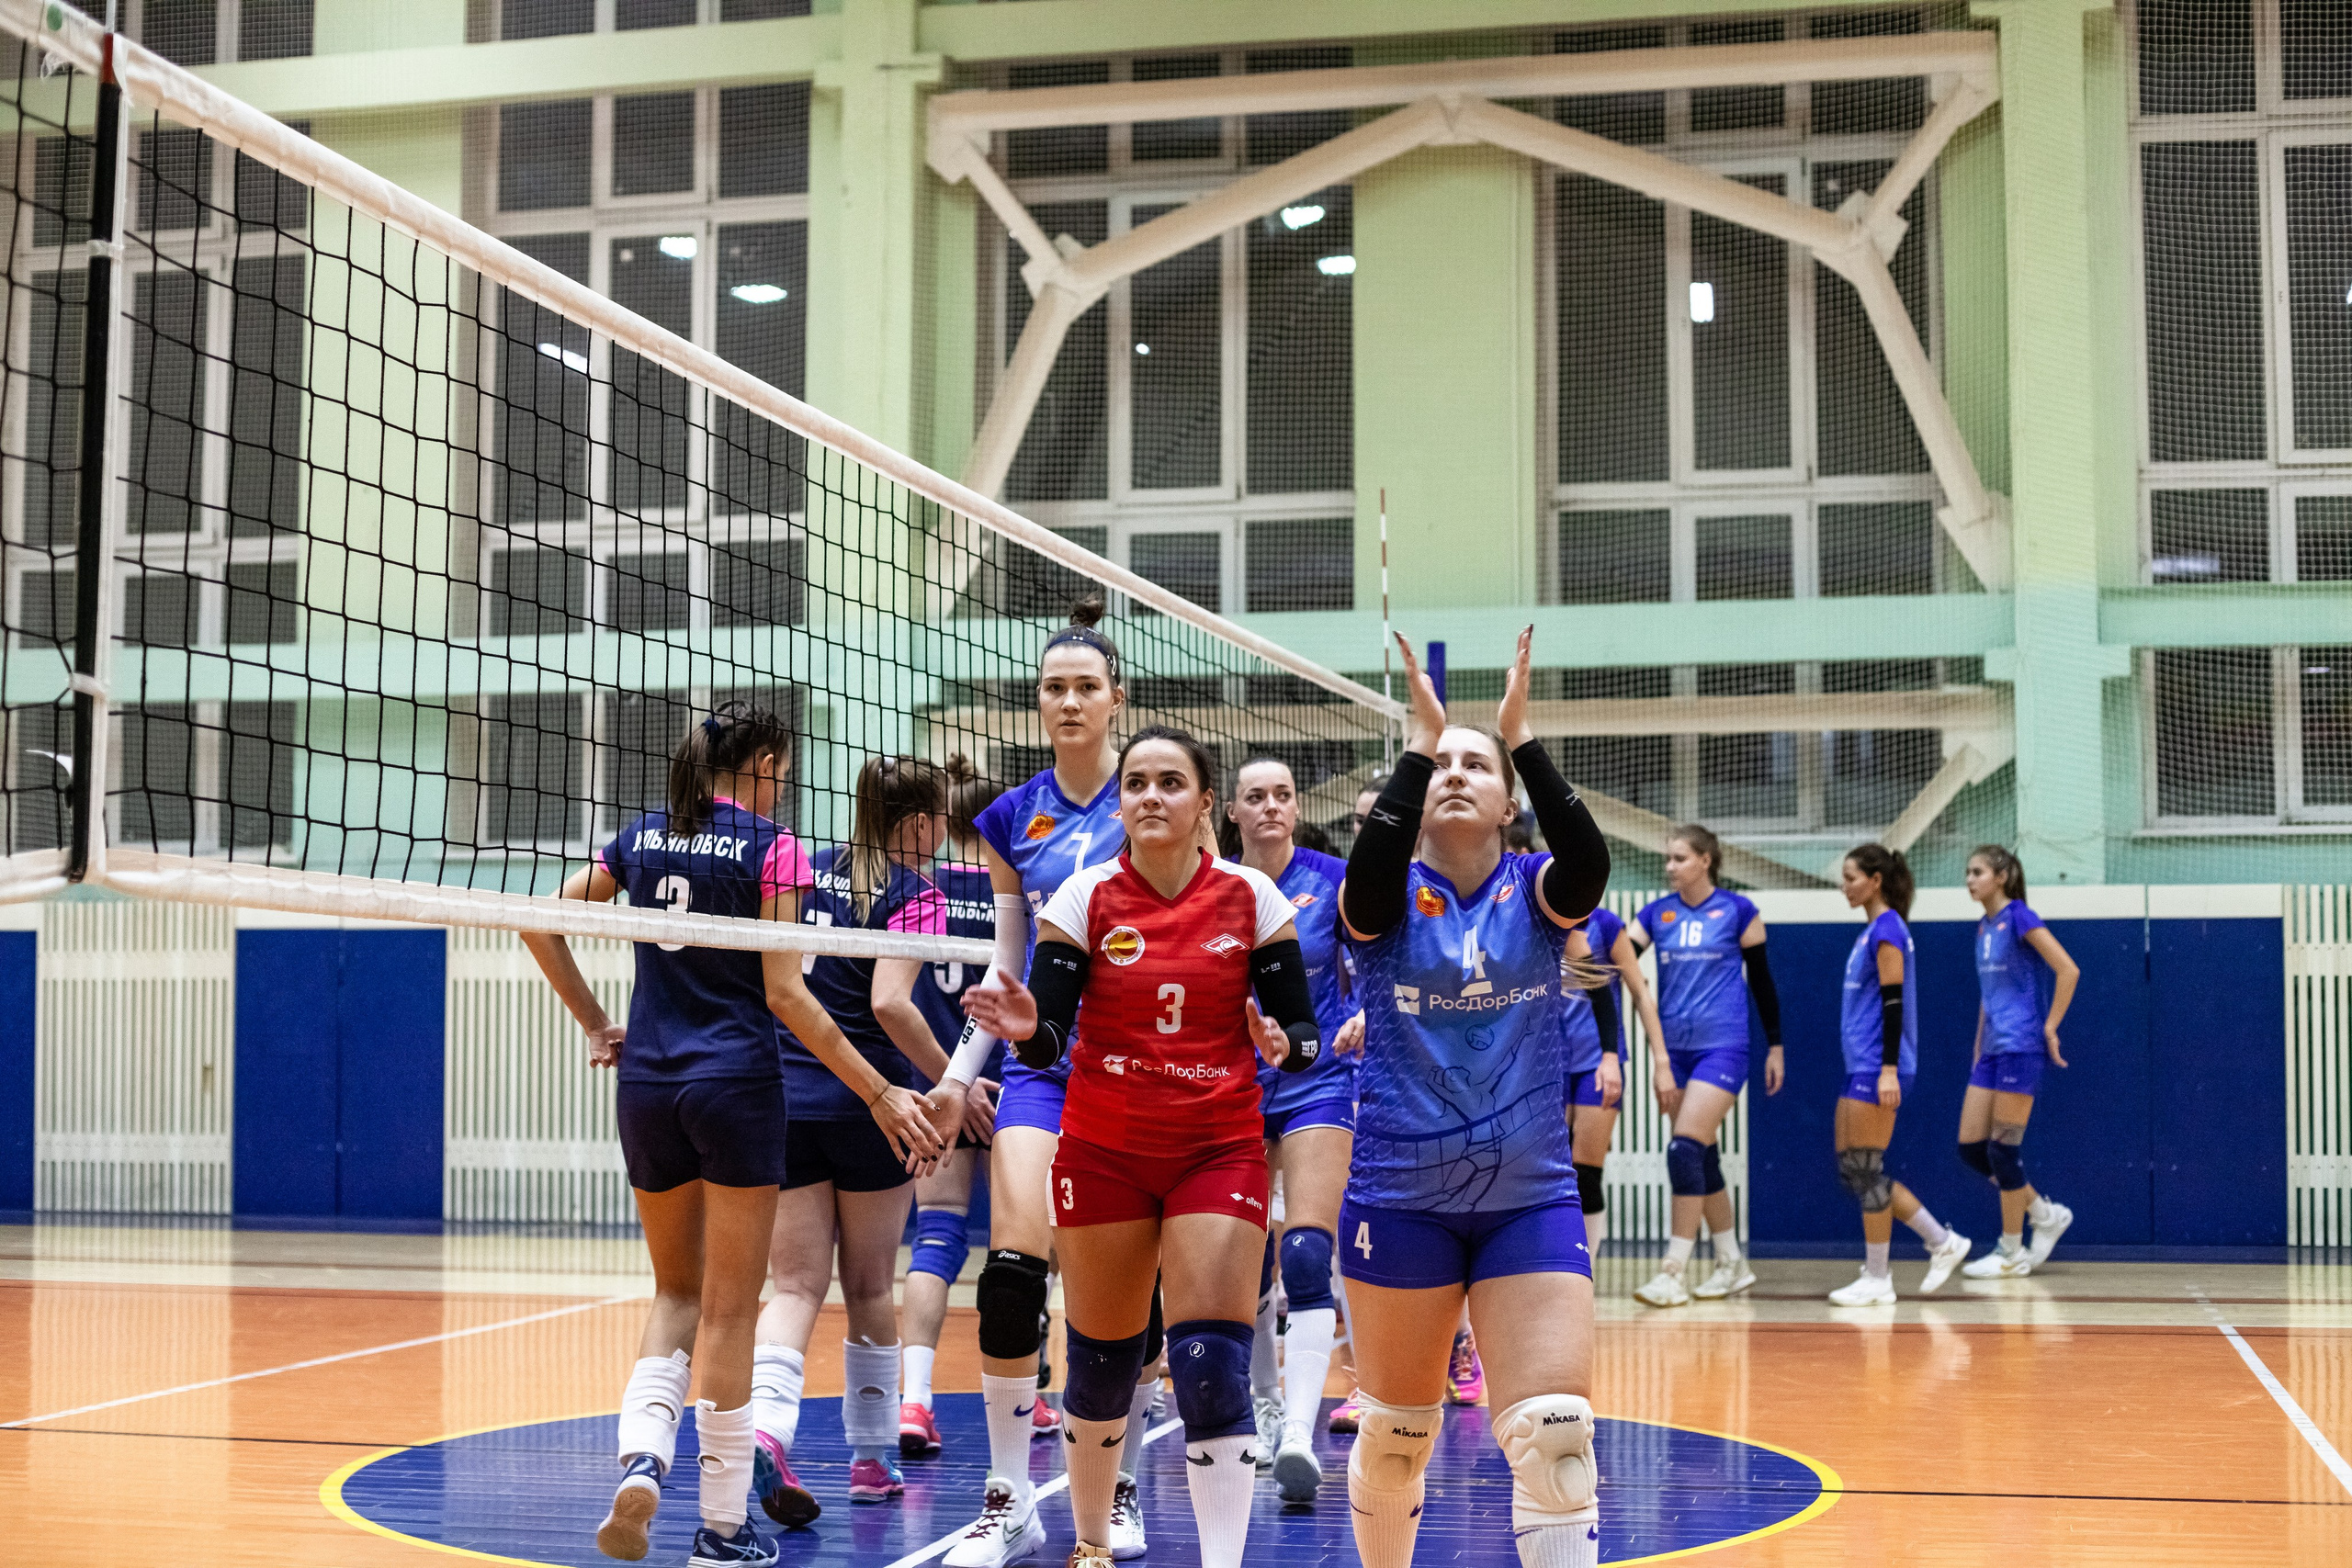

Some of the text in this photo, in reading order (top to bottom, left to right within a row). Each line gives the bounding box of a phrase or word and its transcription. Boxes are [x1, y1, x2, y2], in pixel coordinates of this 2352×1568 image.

[632, 829, 748, 862] УЛЬЯНОВСК
[1070, 831, 1093, 874] 7
[655, 874, 692, 952] 3
[1679, 920, 1703, 947] 16
[1463, 924, 1486, 979] 4
[1157, 983, 1186, 1034] 3
[1430, 984, 1548, 1011] РосДорБанк
[1060, 1178, 1074, 1210] 3
[1354, 1221, 1374, 1259] 4
[1392, 1427, 1428, 1438] MIKASA
[1544, 1412, 1581, 1426] MIKASA
